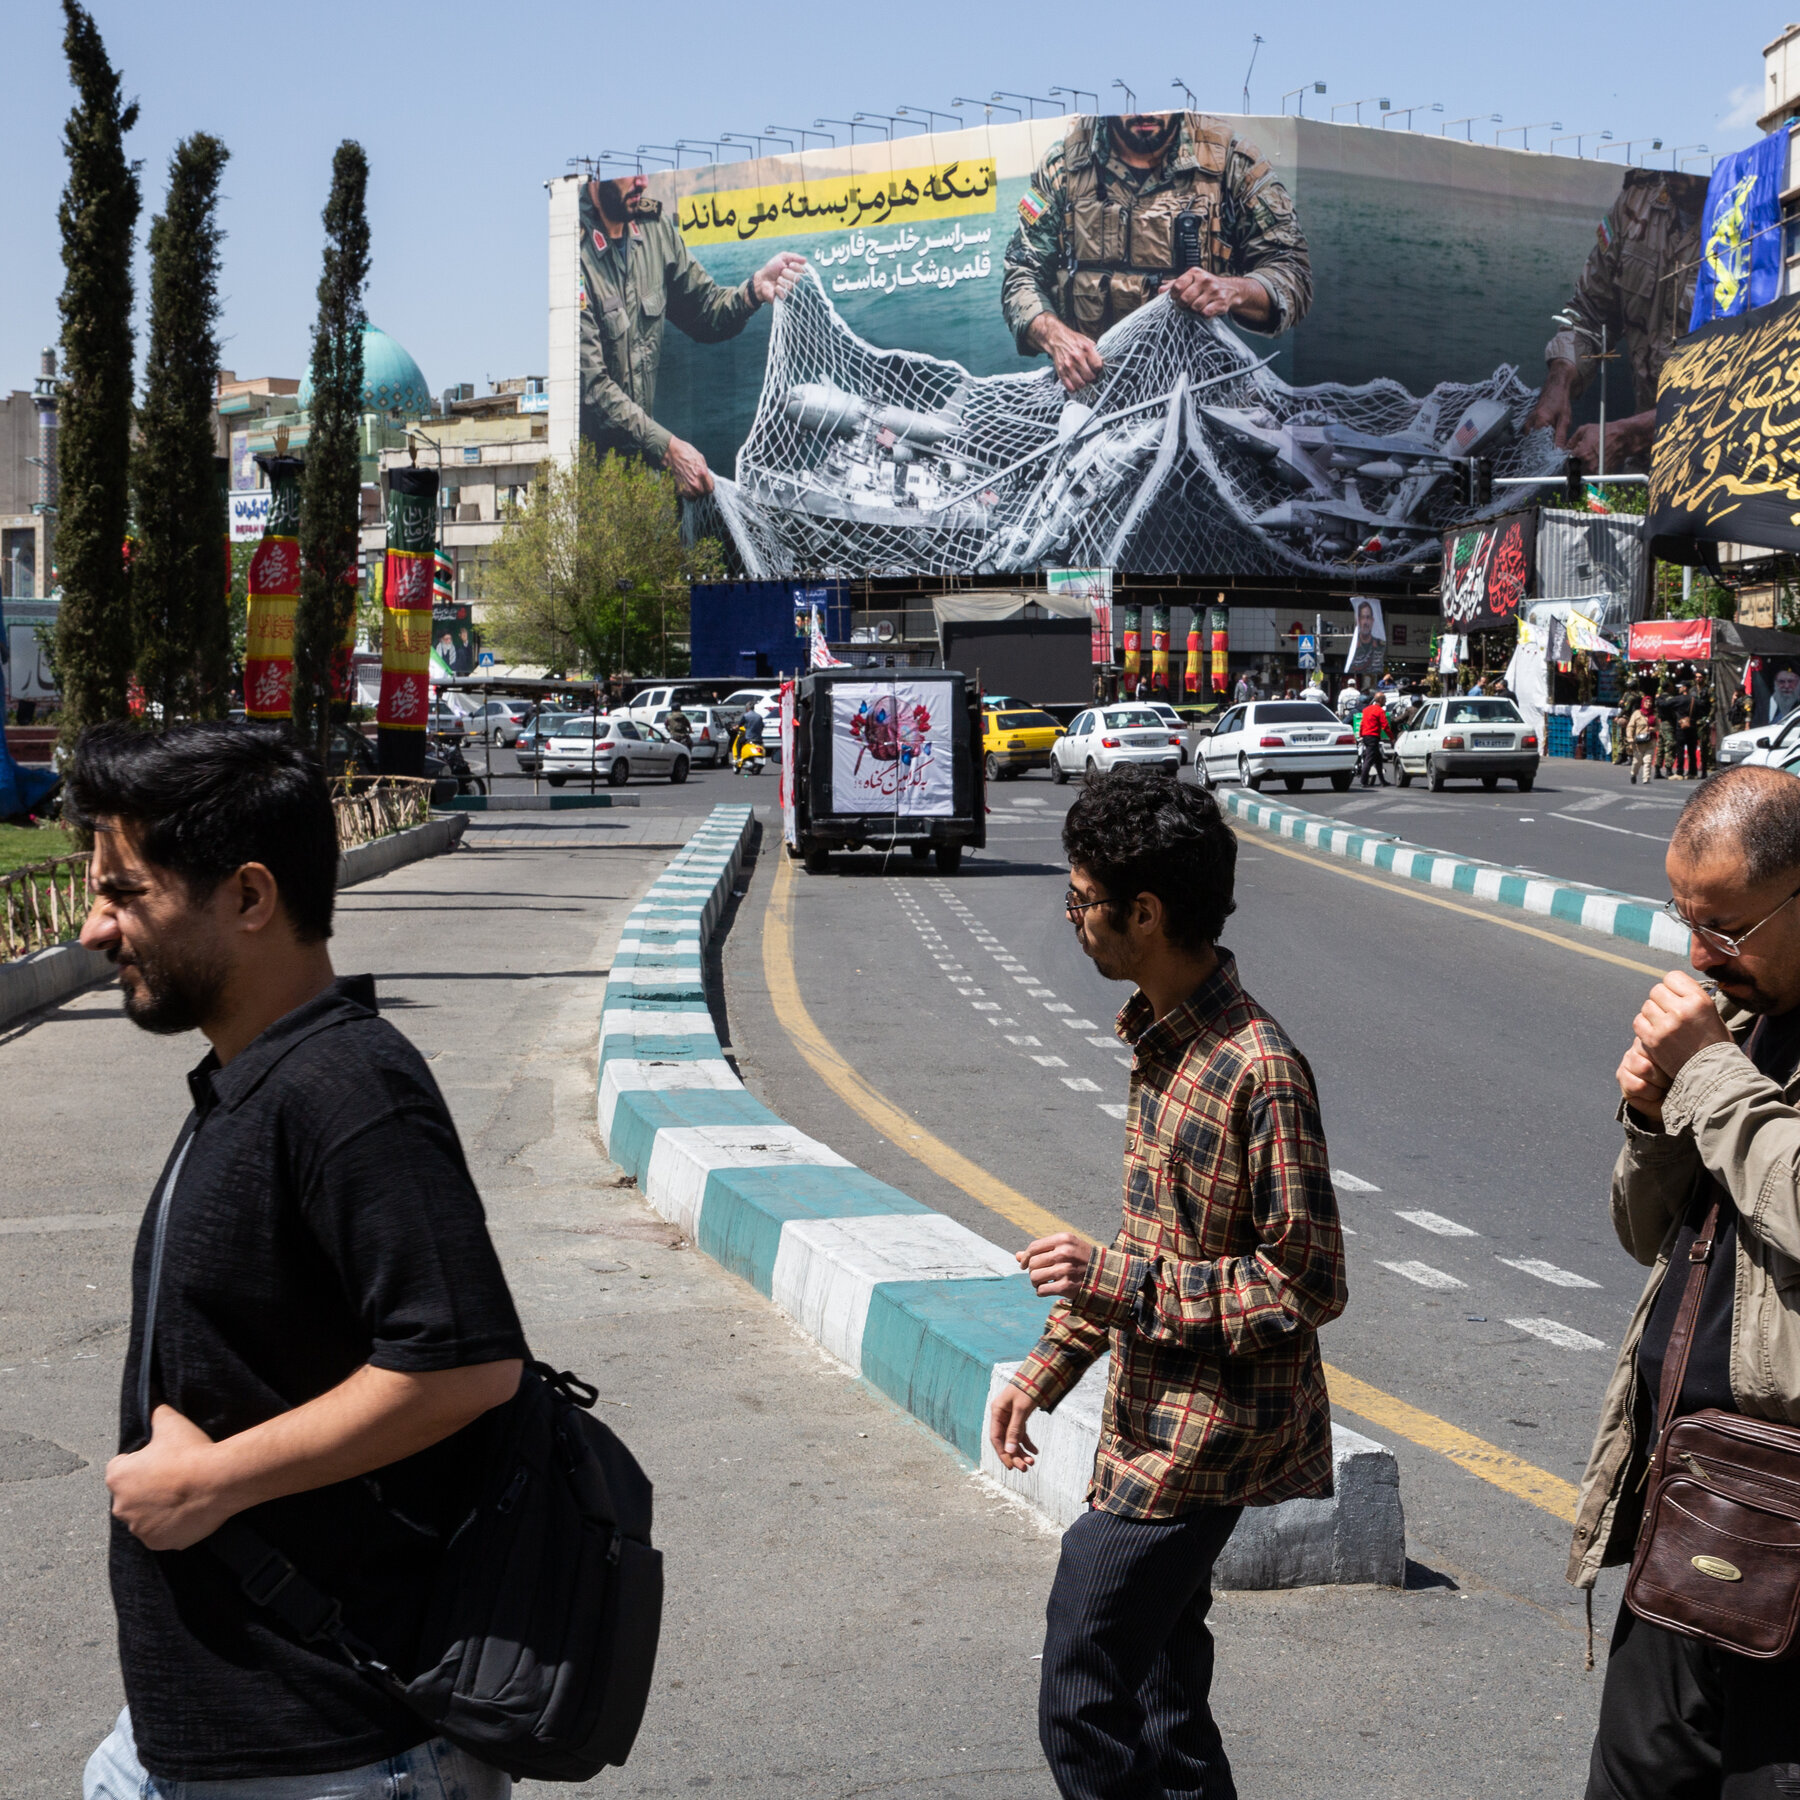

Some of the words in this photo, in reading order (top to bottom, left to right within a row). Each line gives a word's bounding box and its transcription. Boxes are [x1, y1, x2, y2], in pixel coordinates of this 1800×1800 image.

[922, 160, 990, 202] تنگه
[780, 192, 849, 224] بسته
[847, 178, 919, 226] هرمز
[866, 228, 920, 263] خلیج
[918, 222, 991, 254] سراسر
[831, 264, 887, 293] ماست
[885, 257, 944, 295] شکار
[938, 254, 991, 289] قلمرو
